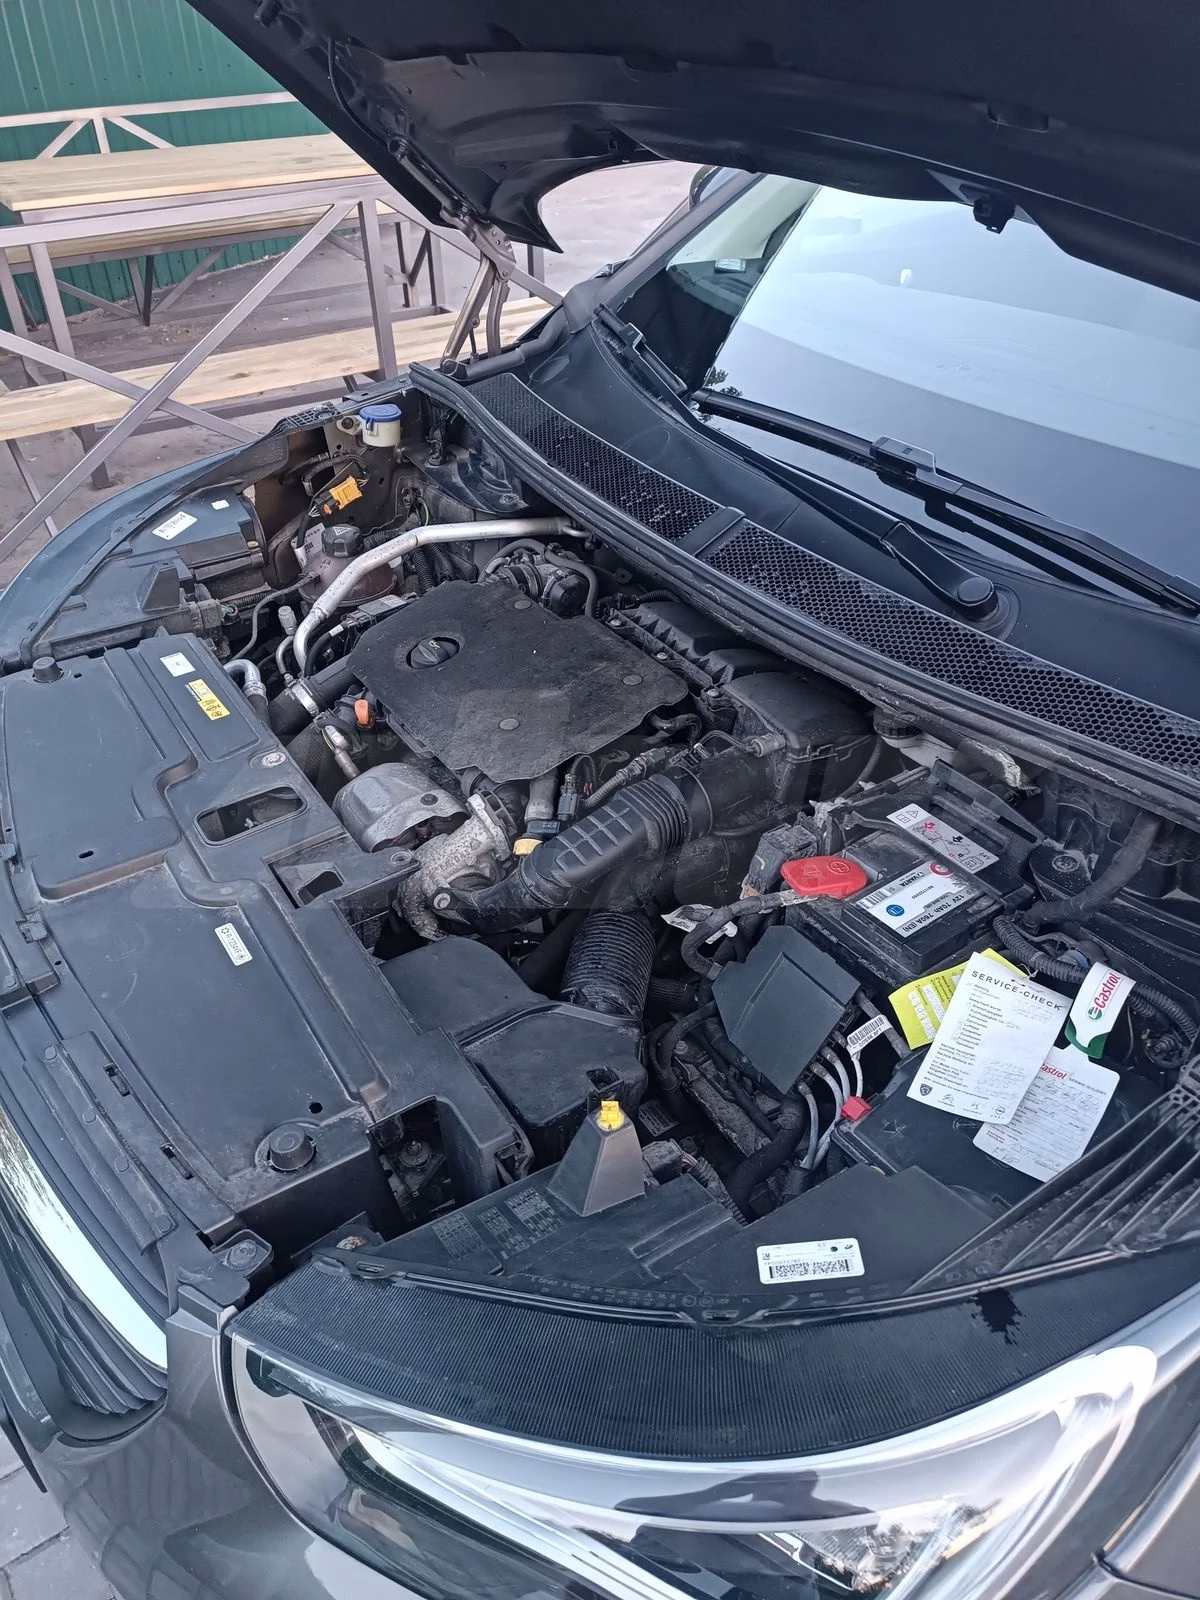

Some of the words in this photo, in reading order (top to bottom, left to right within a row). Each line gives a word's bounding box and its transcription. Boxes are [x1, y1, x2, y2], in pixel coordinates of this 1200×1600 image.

[934, 902, 951, 914] 70Ah
[952, 894, 965, 905] 12V
[971, 970, 1063, 1011] SERVICE-CHECK
[1094, 972, 1120, 1009] Castrol
